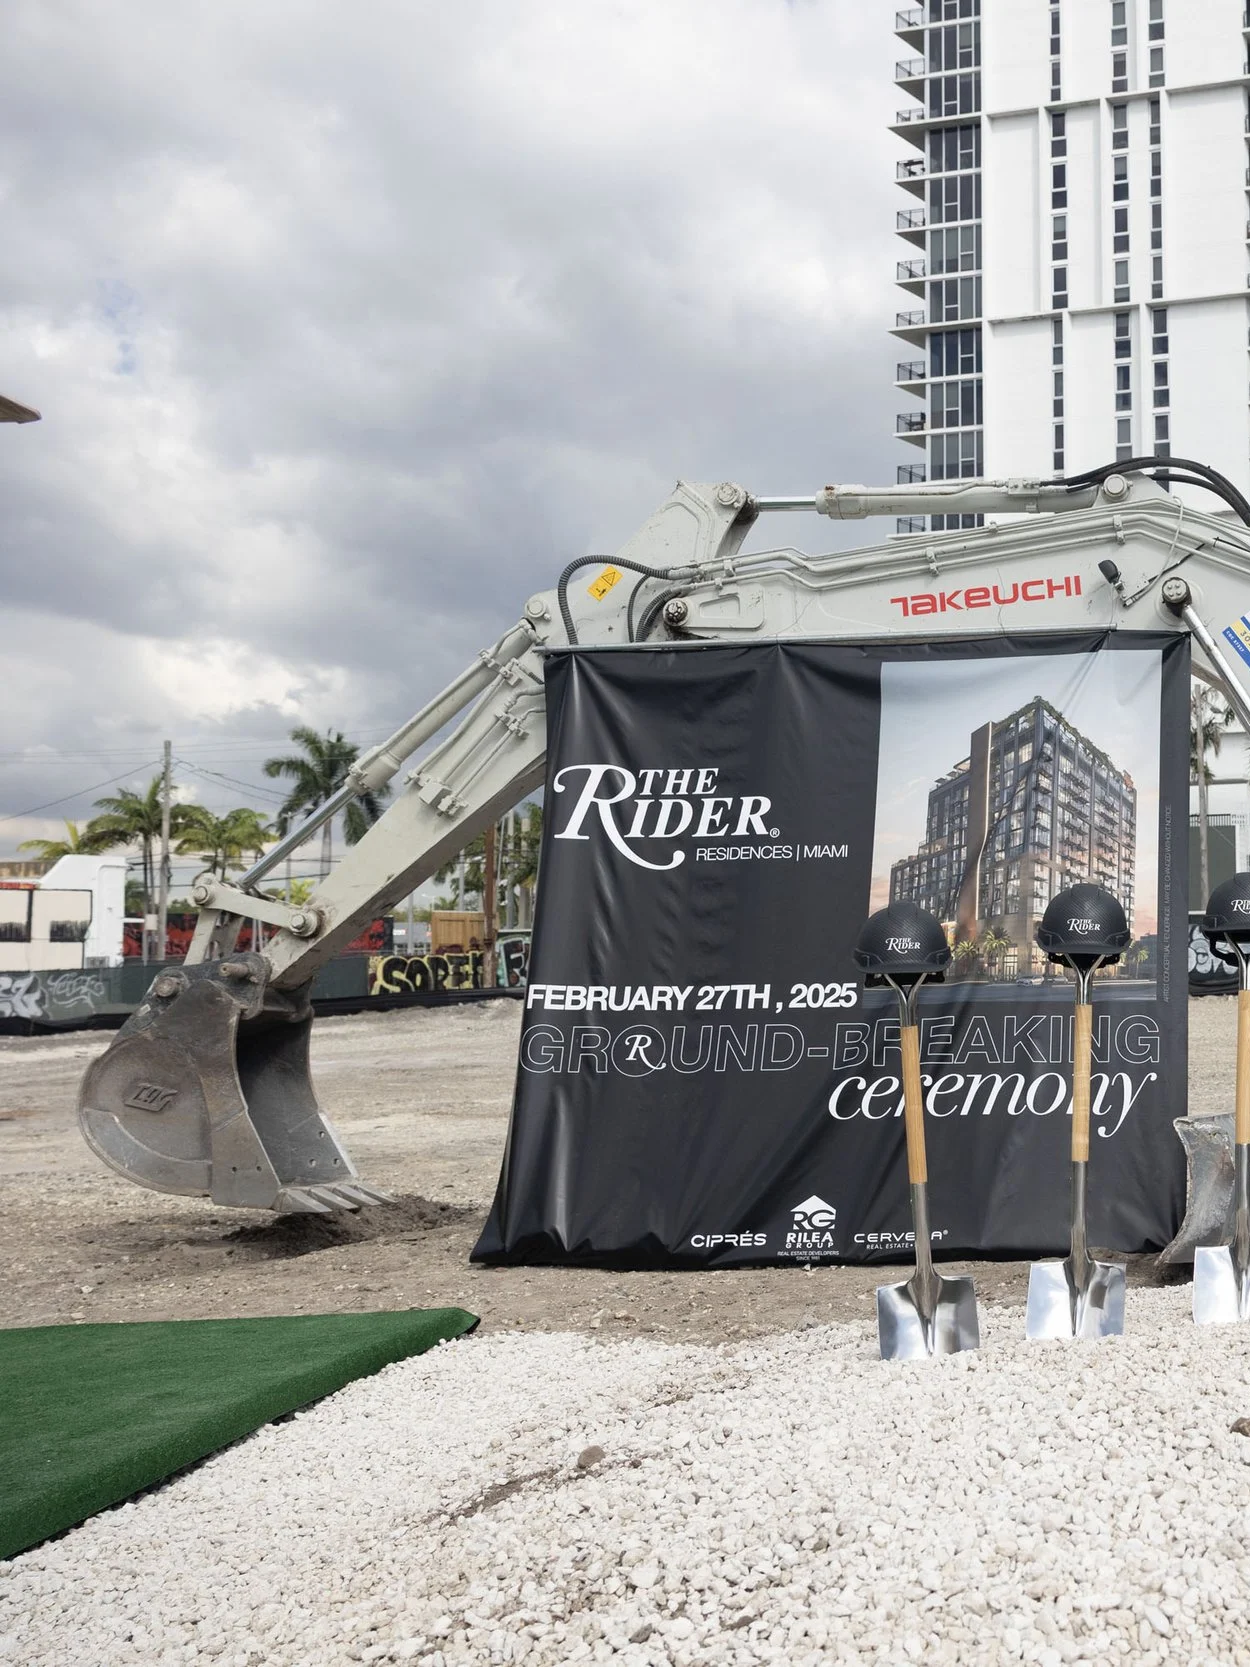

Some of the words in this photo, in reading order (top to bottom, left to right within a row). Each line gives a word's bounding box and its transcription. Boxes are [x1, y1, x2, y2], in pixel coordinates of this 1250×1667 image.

[890, 575, 1082, 617] TAKEUCHI
[638, 767, 719, 796] THE
[696, 845, 793, 861] RESIDENCES
[803, 844, 848, 858] MIAMI
[1066, 918, 1100, 934] RIDER
[885, 937, 921, 954] RIDER
[526, 984, 694, 1011] FEBRUARY
[788, 982, 858, 1009] 2025
[690, 1230, 767, 1248] CIPRÉS
[785, 1232, 834, 1243] RILEA
